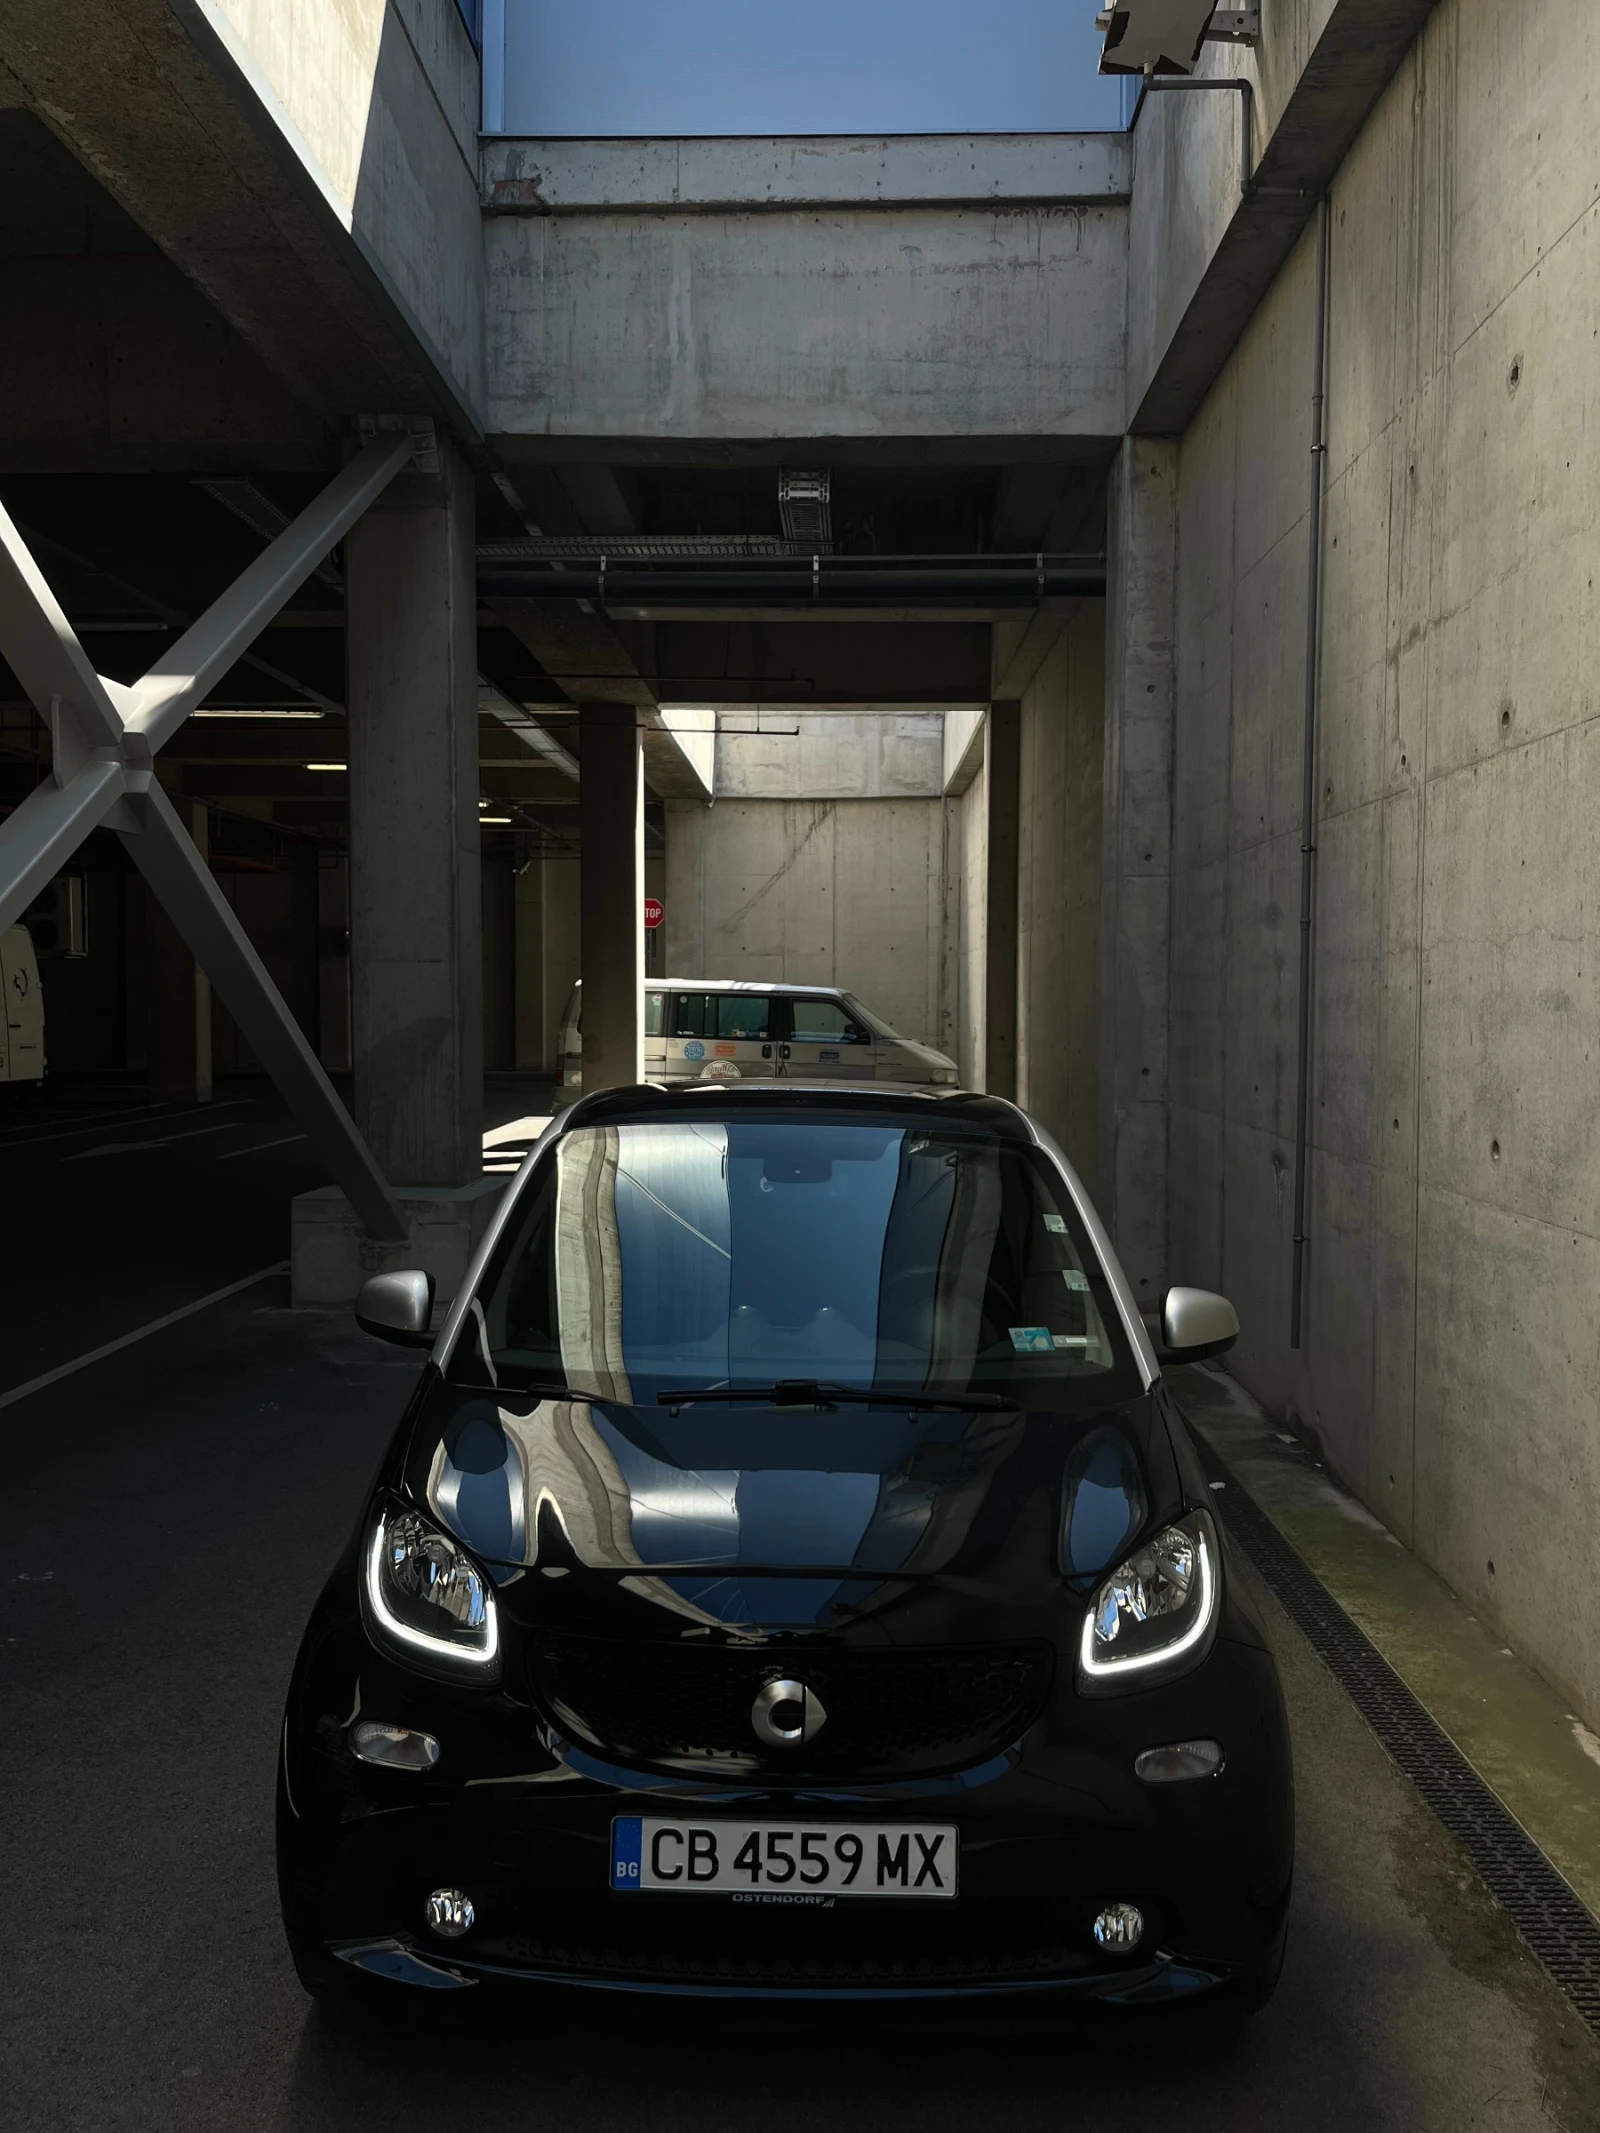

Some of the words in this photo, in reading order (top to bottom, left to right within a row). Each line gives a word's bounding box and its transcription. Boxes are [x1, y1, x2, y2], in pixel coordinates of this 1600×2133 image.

[645, 908, 661, 918] TOP
[651, 1827, 720, 1881] CB
[733, 1831, 864, 1885] 4559
[877, 1833, 945, 1888] MX
[616, 1862, 638, 1878] BG
[732, 1893, 825, 1904] OSTENDORF
